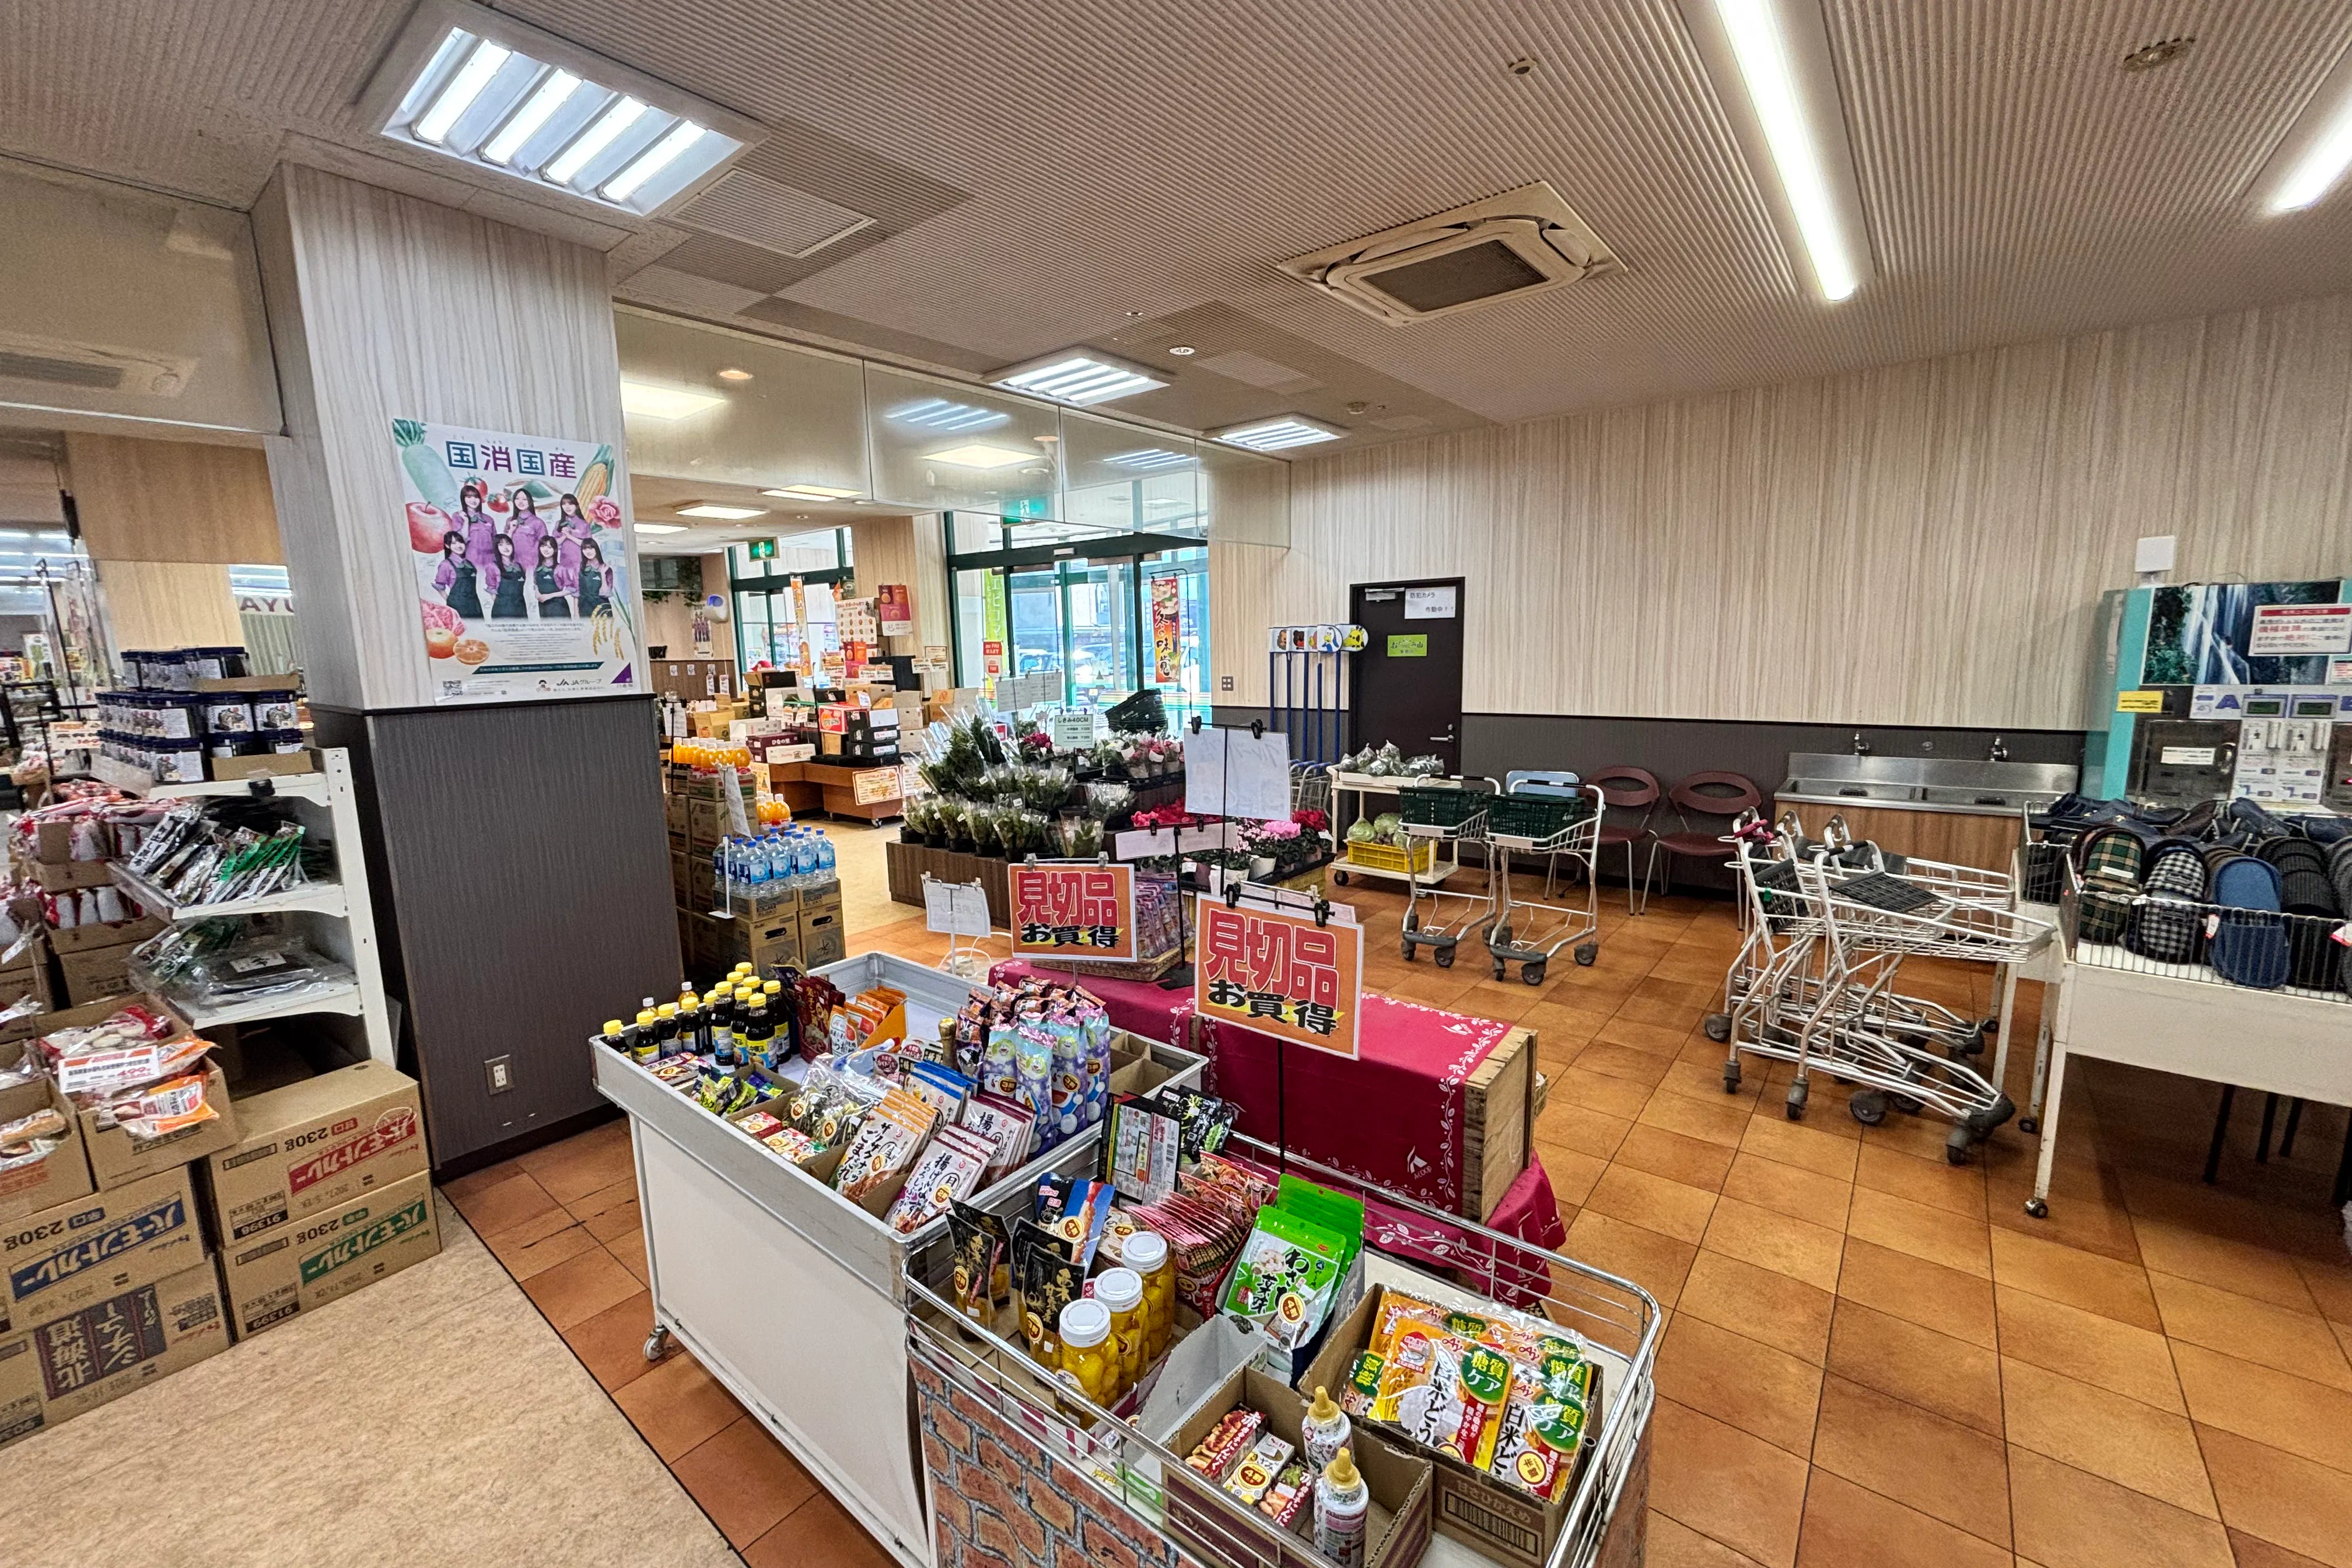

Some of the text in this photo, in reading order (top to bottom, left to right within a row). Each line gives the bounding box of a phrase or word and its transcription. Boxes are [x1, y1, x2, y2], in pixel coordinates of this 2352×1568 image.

[446, 440, 577, 479] 国消国産
[1154, 608, 1172, 680] 冬の味覚
[1016, 870, 1119, 928] 見切品
[1204, 908, 1340, 1010] 見切品
[285, 1127, 328, 1152] 230g
[3, 1220, 64, 1251] 230g
[241, 1214, 281, 1237] 91398
[297, 1219, 339, 1245] 230g
[307, 1204, 420, 1274] バーモントカレー
[22, 1203, 176, 1286] バーモントカレー
[253, 1306, 293, 1328] 91399
[48, 1315, 93, 1388] 北海道
[95, 1303, 138, 1371] シチュー
[1356, 1355, 1381, 1387] 糖質
[1467, 1368, 1502, 1392] ケア
[1471, 1350, 1506, 1381] 糖質
[1540, 1417, 1574, 1439] ケア
[1456, 1478, 1534, 1524] 甘さひかえめ
